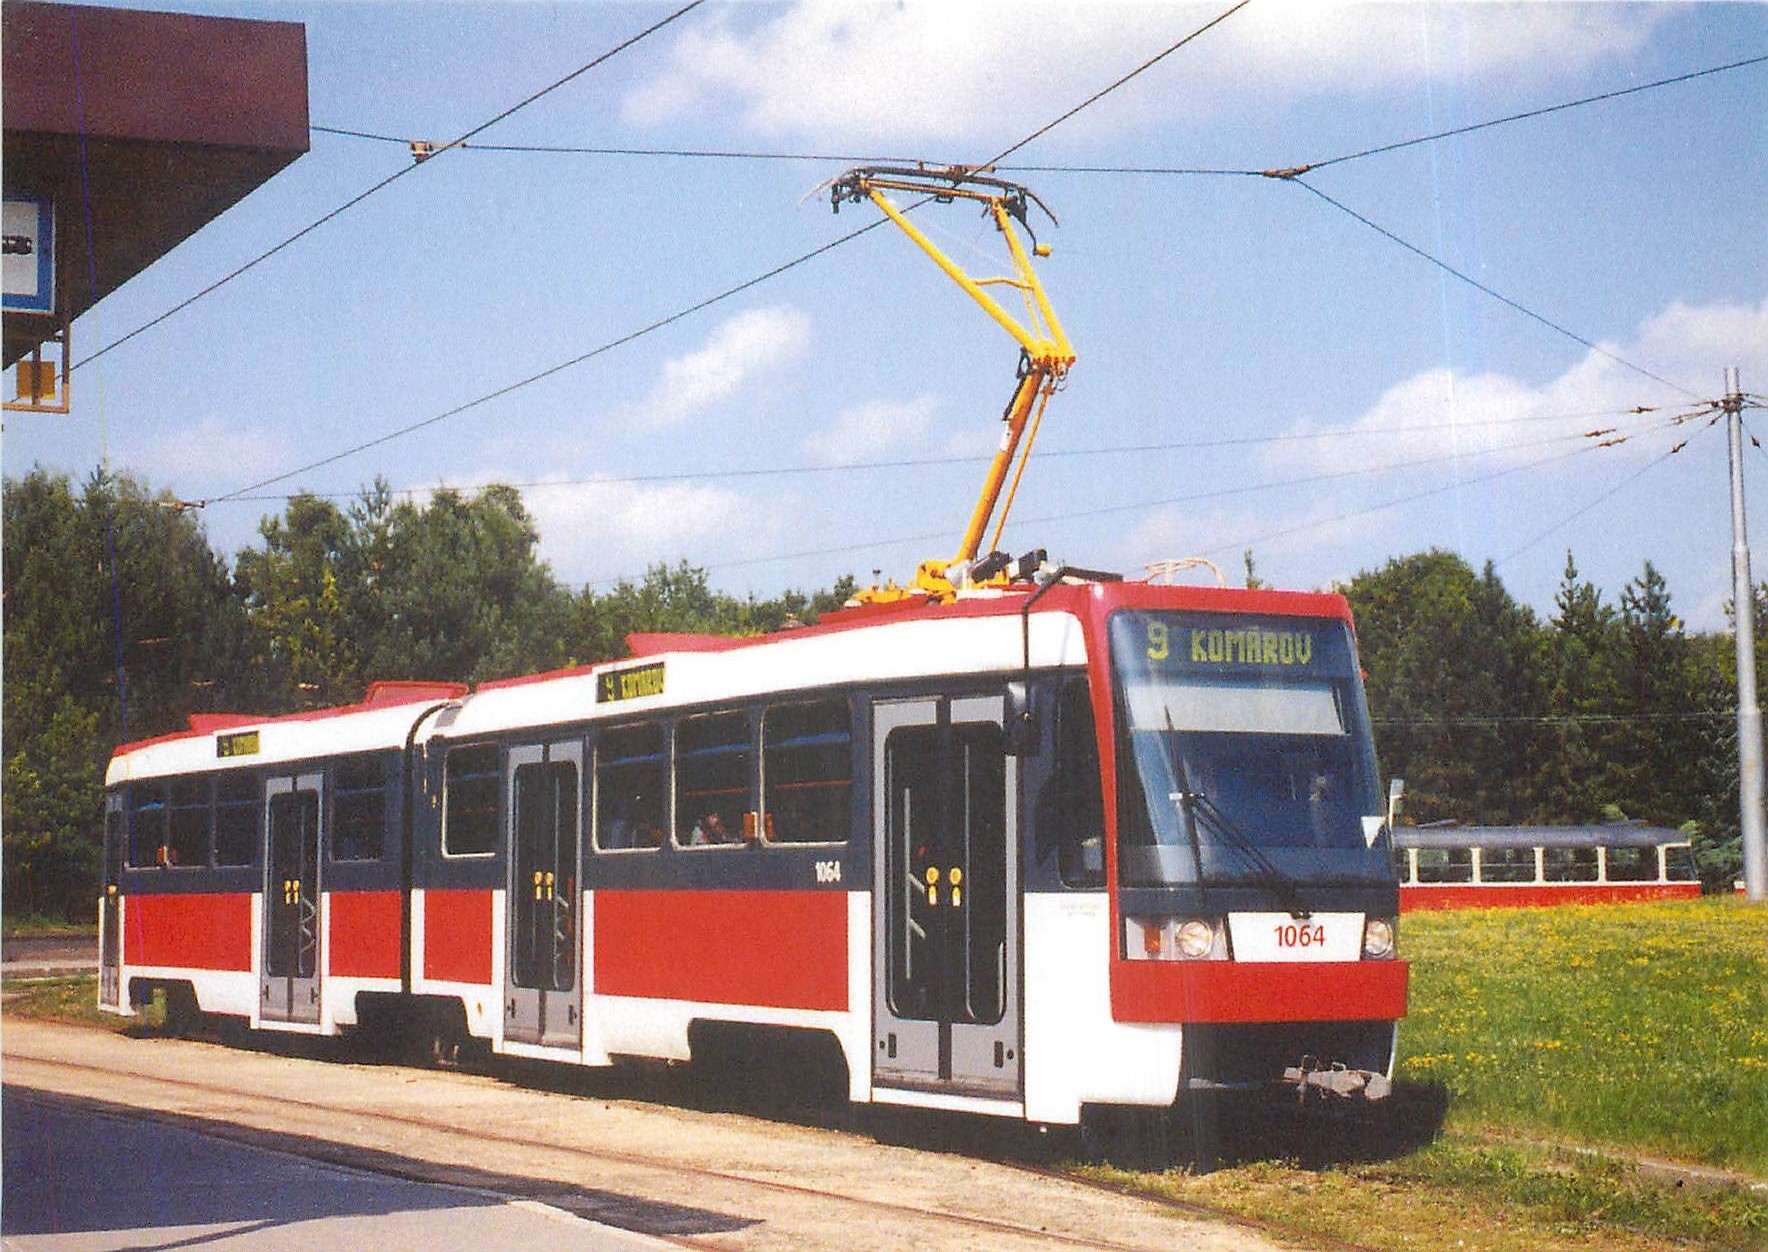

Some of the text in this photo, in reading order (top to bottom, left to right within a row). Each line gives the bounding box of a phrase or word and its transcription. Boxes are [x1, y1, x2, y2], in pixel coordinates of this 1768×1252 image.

[1147, 621, 1168, 660] 9
[815, 860, 841, 882] 1064
[1274, 925, 1325, 947] 1064
